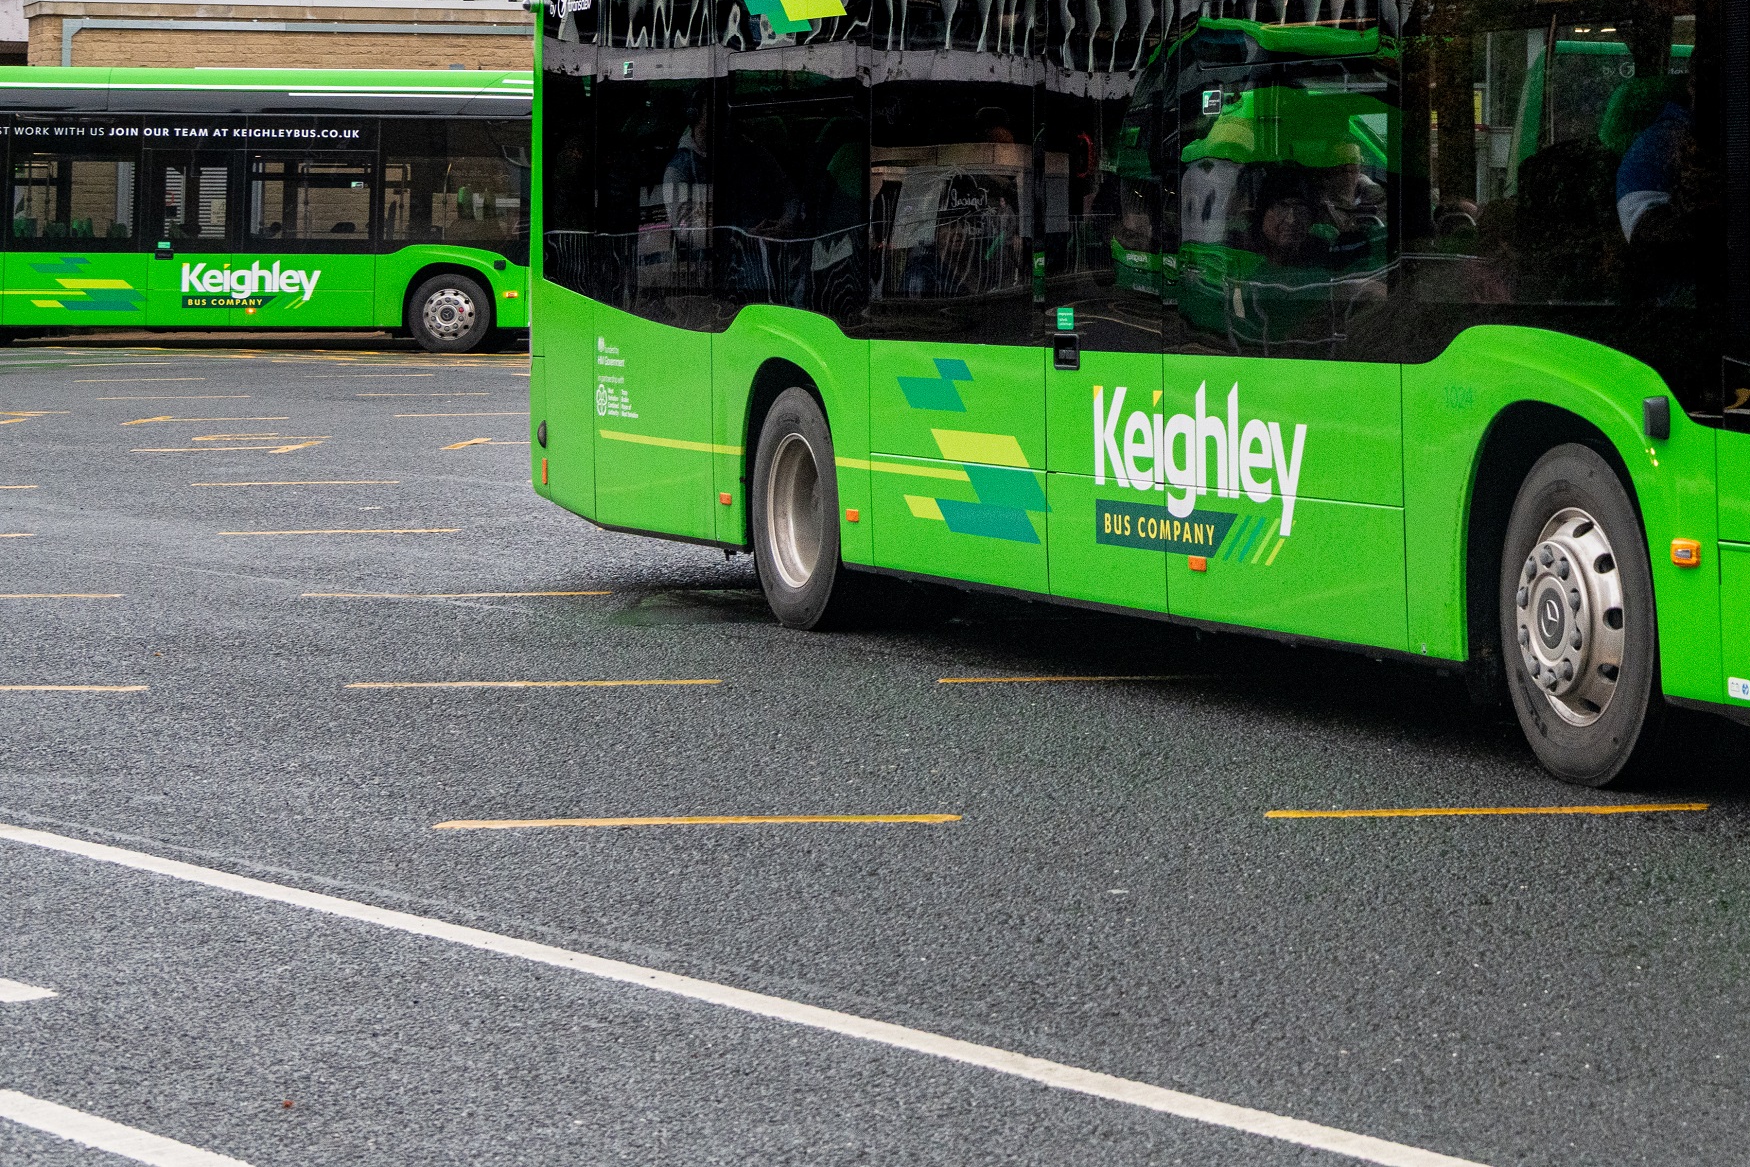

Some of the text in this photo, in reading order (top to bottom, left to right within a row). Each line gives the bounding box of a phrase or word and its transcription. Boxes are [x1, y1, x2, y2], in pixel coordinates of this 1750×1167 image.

[14, 127, 50, 135] WORK
[54, 127, 85, 136] WITH
[90, 128, 105, 136] US
[109, 128, 139, 136] JOIN
[143, 128, 169, 136] OUR
[174, 128, 208, 137] TEAM
[212, 128, 229, 137] AT
[233, 128, 360, 138] KEIGHLEYBUS.CO.UK
[181, 260, 322, 300] Keighley
[1094, 380, 1307, 536] Keighley
[1104, 513, 1214, 546] BUS COMPANY
